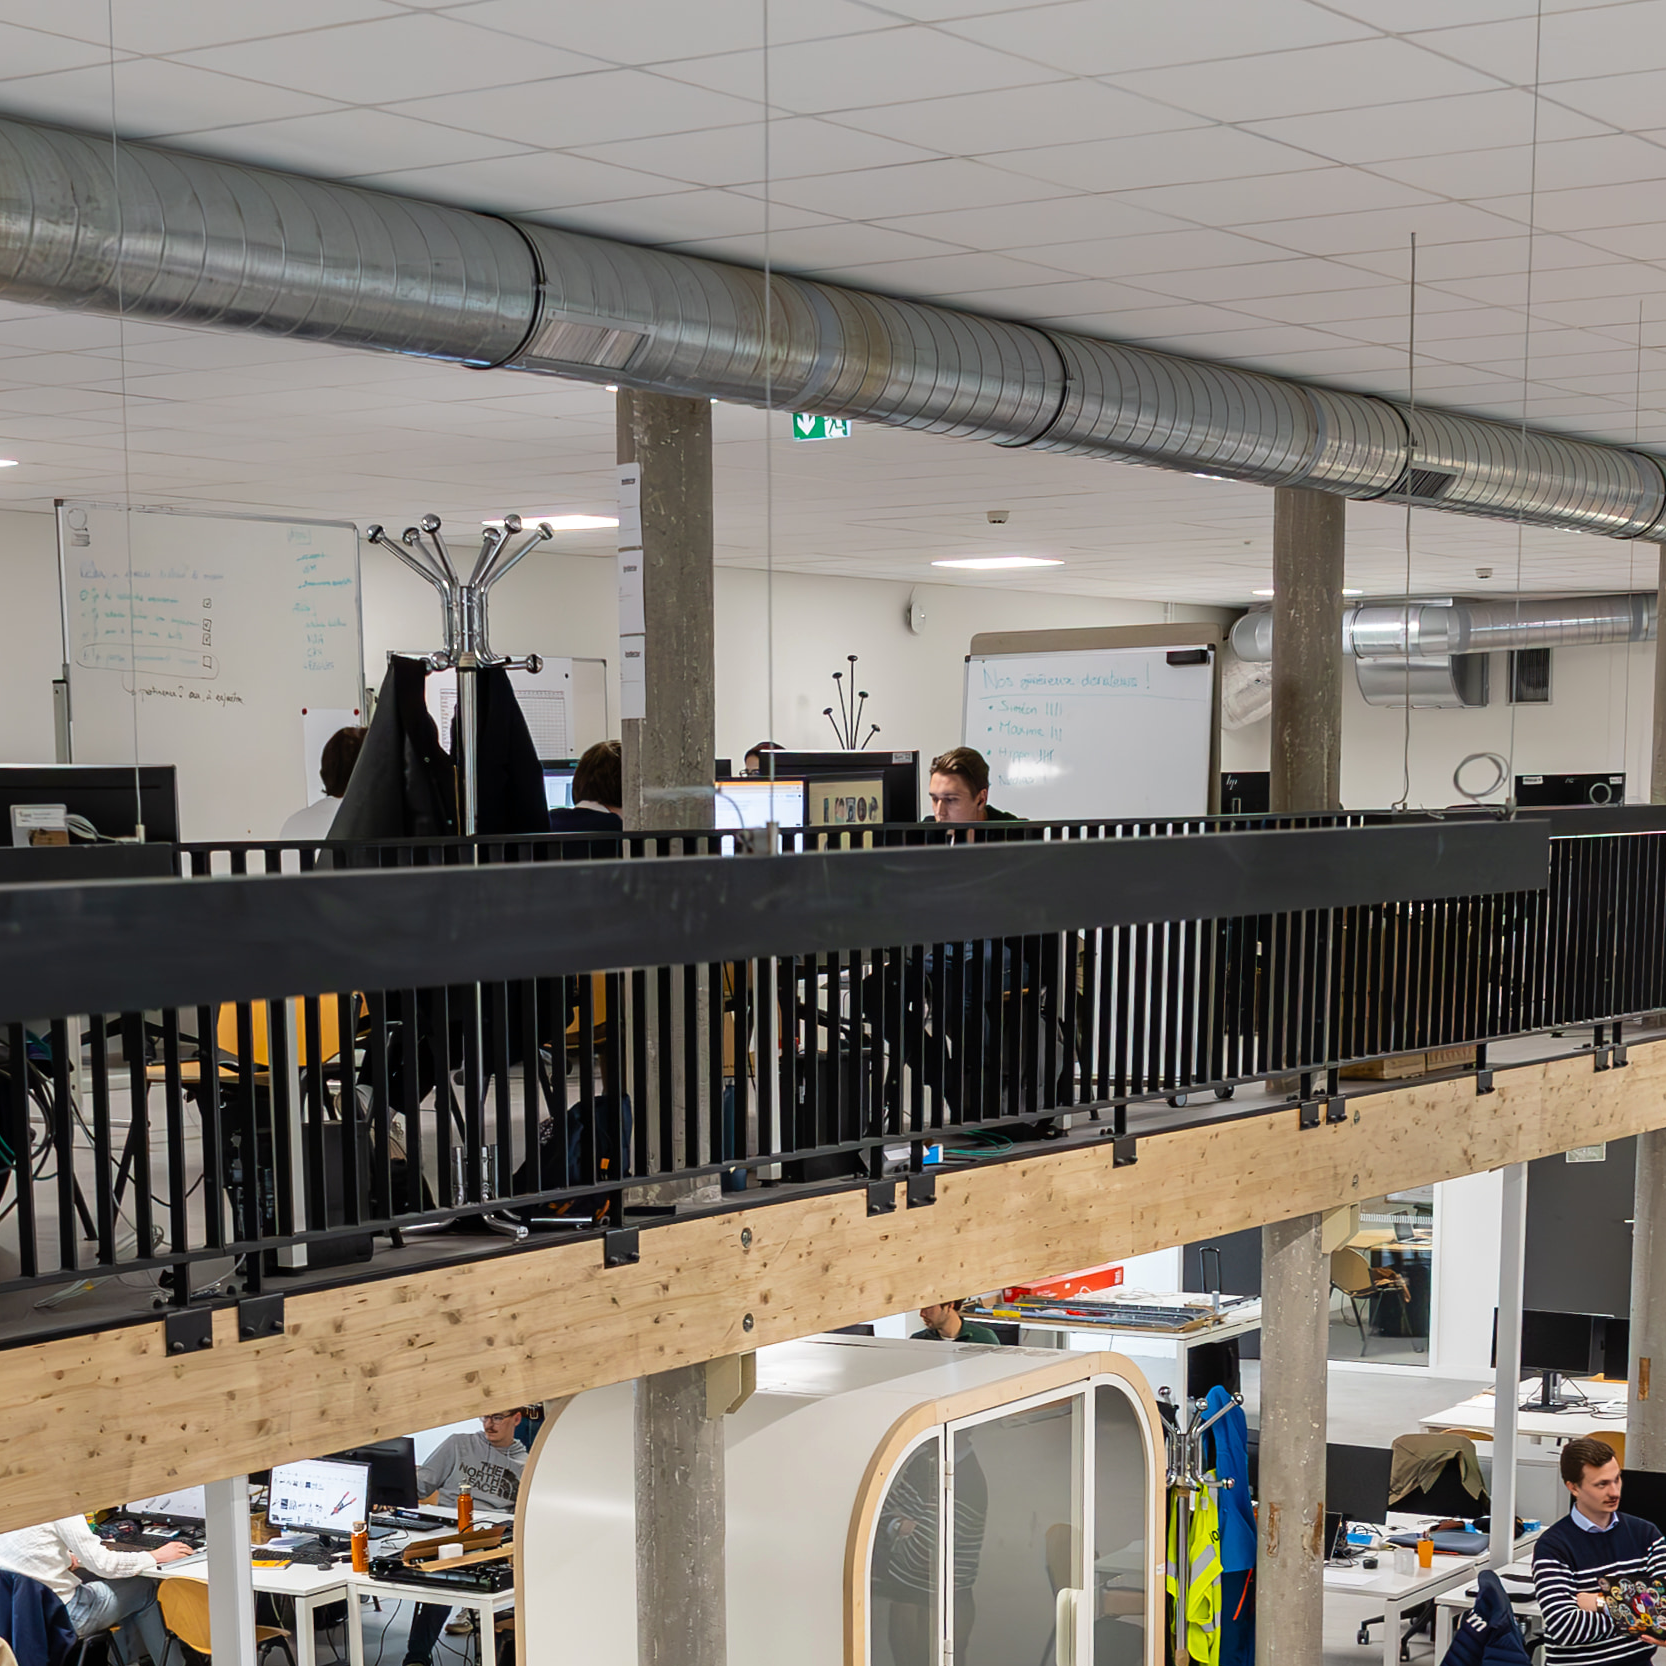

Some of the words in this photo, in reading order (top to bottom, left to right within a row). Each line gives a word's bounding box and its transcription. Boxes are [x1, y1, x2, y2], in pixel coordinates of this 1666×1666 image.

[983, 667, 1014, 690] Nos
[459, 1462, 502, 1487] NORTH
[481, 1461, 504, 1476] THE
[468, 1477, 498, 1494] FACE
